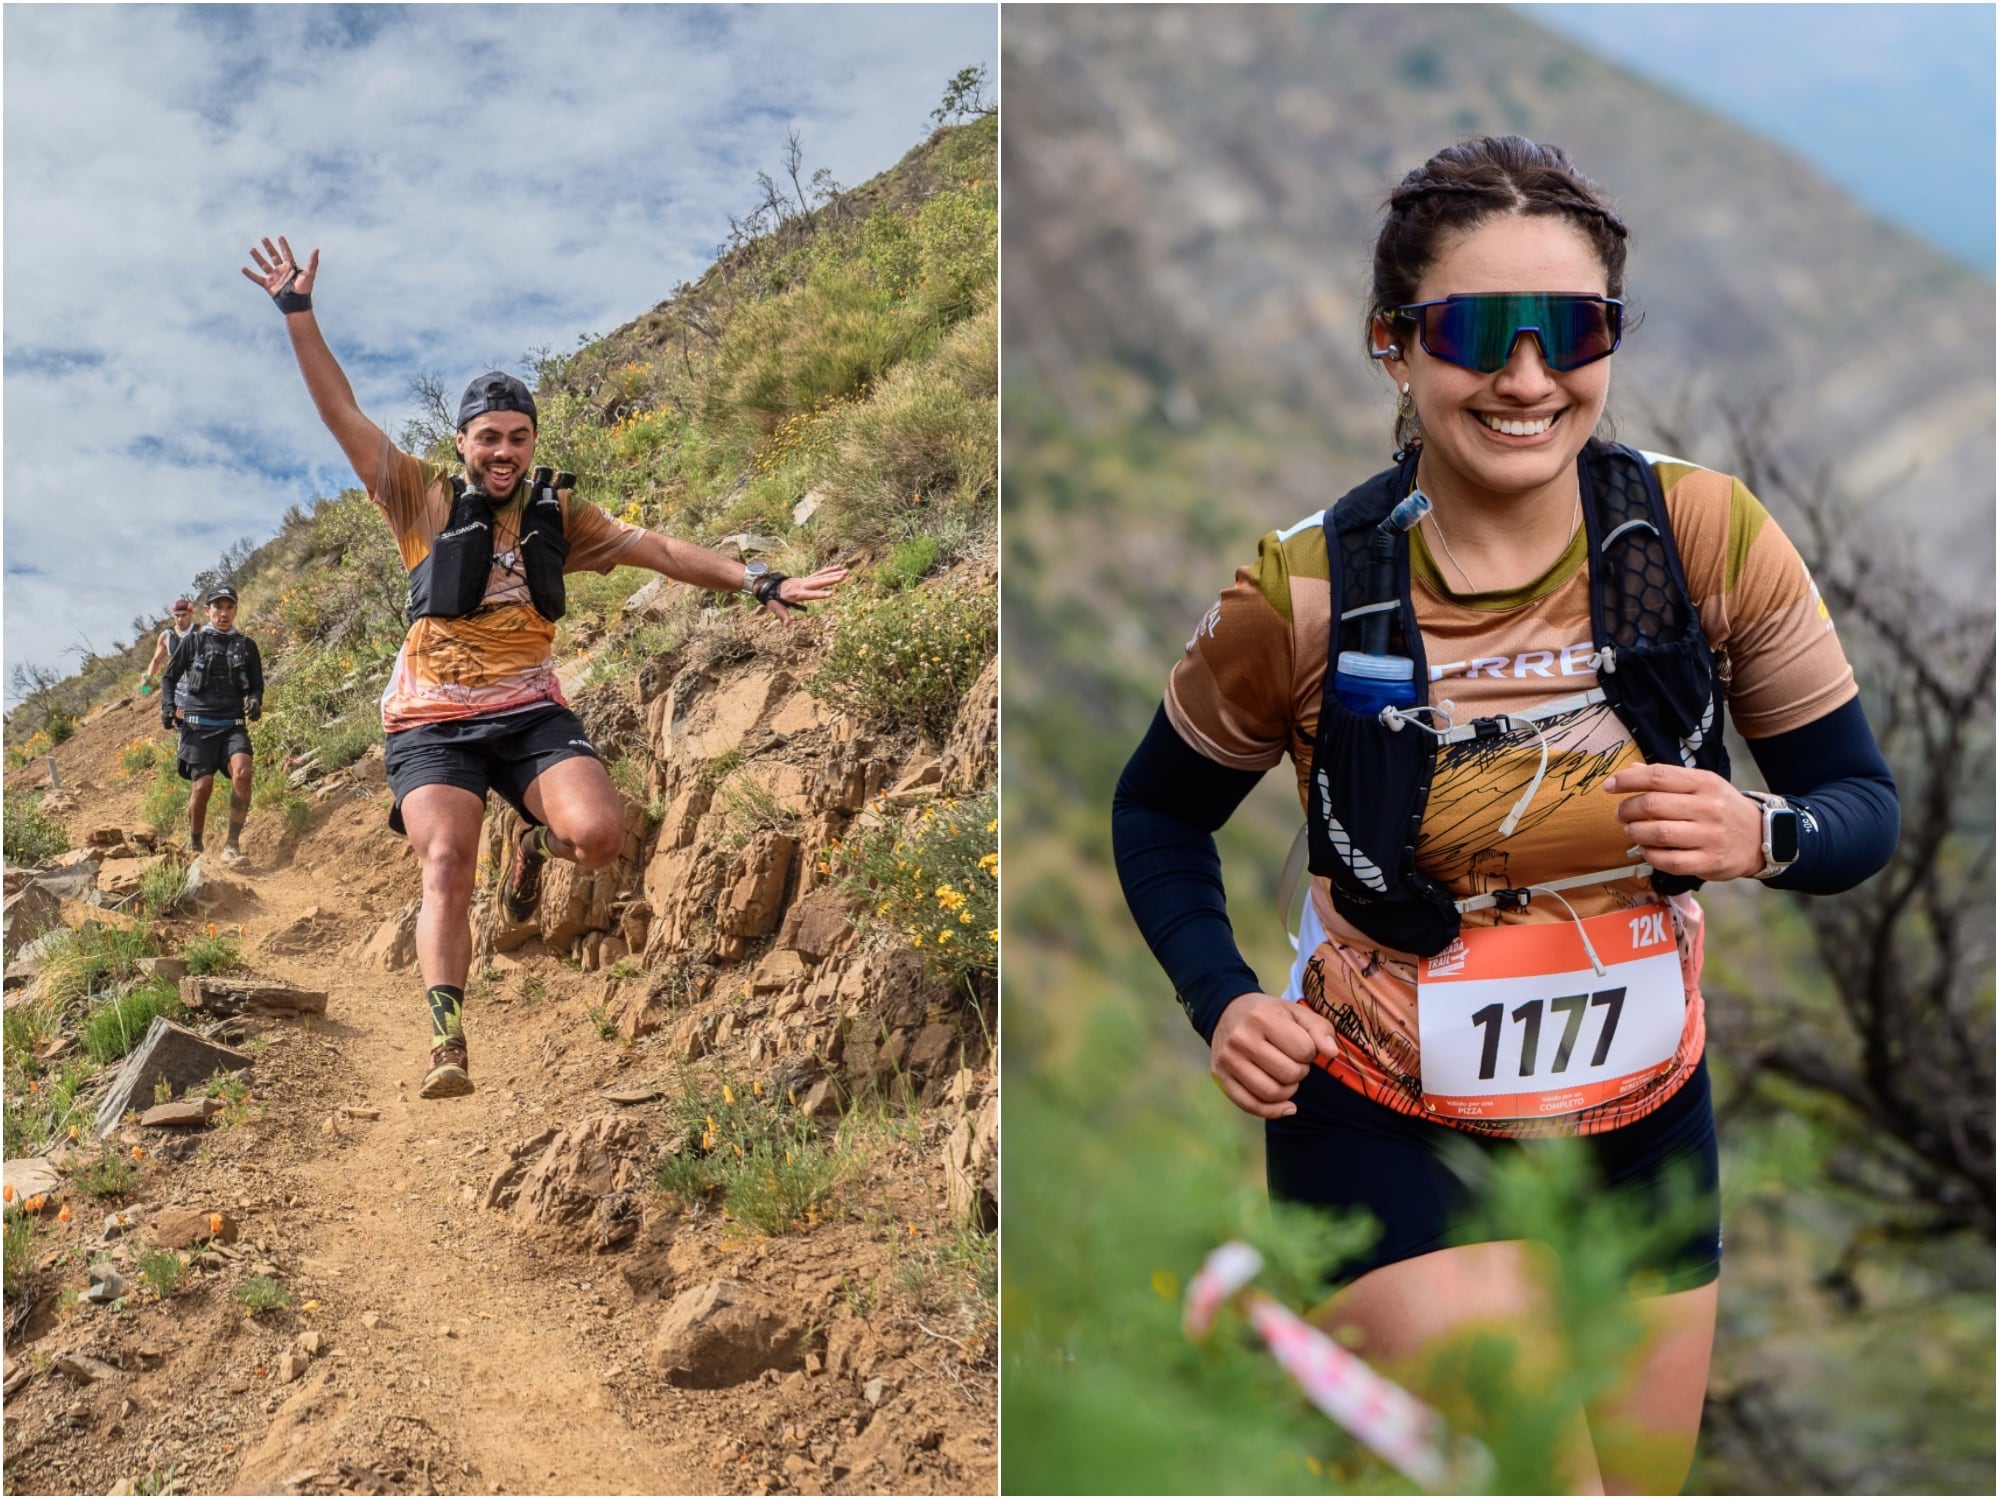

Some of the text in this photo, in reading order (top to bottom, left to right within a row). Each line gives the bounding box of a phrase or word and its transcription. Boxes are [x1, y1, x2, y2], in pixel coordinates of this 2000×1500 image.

[1430, 641, 1598, 682] ERRE
[1629, 911, 1667, 949] 12K
[1428, 954, 1451, 970] TRAIL
[1471, 986, 1627, 1080] 1177
[1458, 1107, 1484, 1115] PIZZA
[1539, 1097, 1585, 1112] COMPLETO
